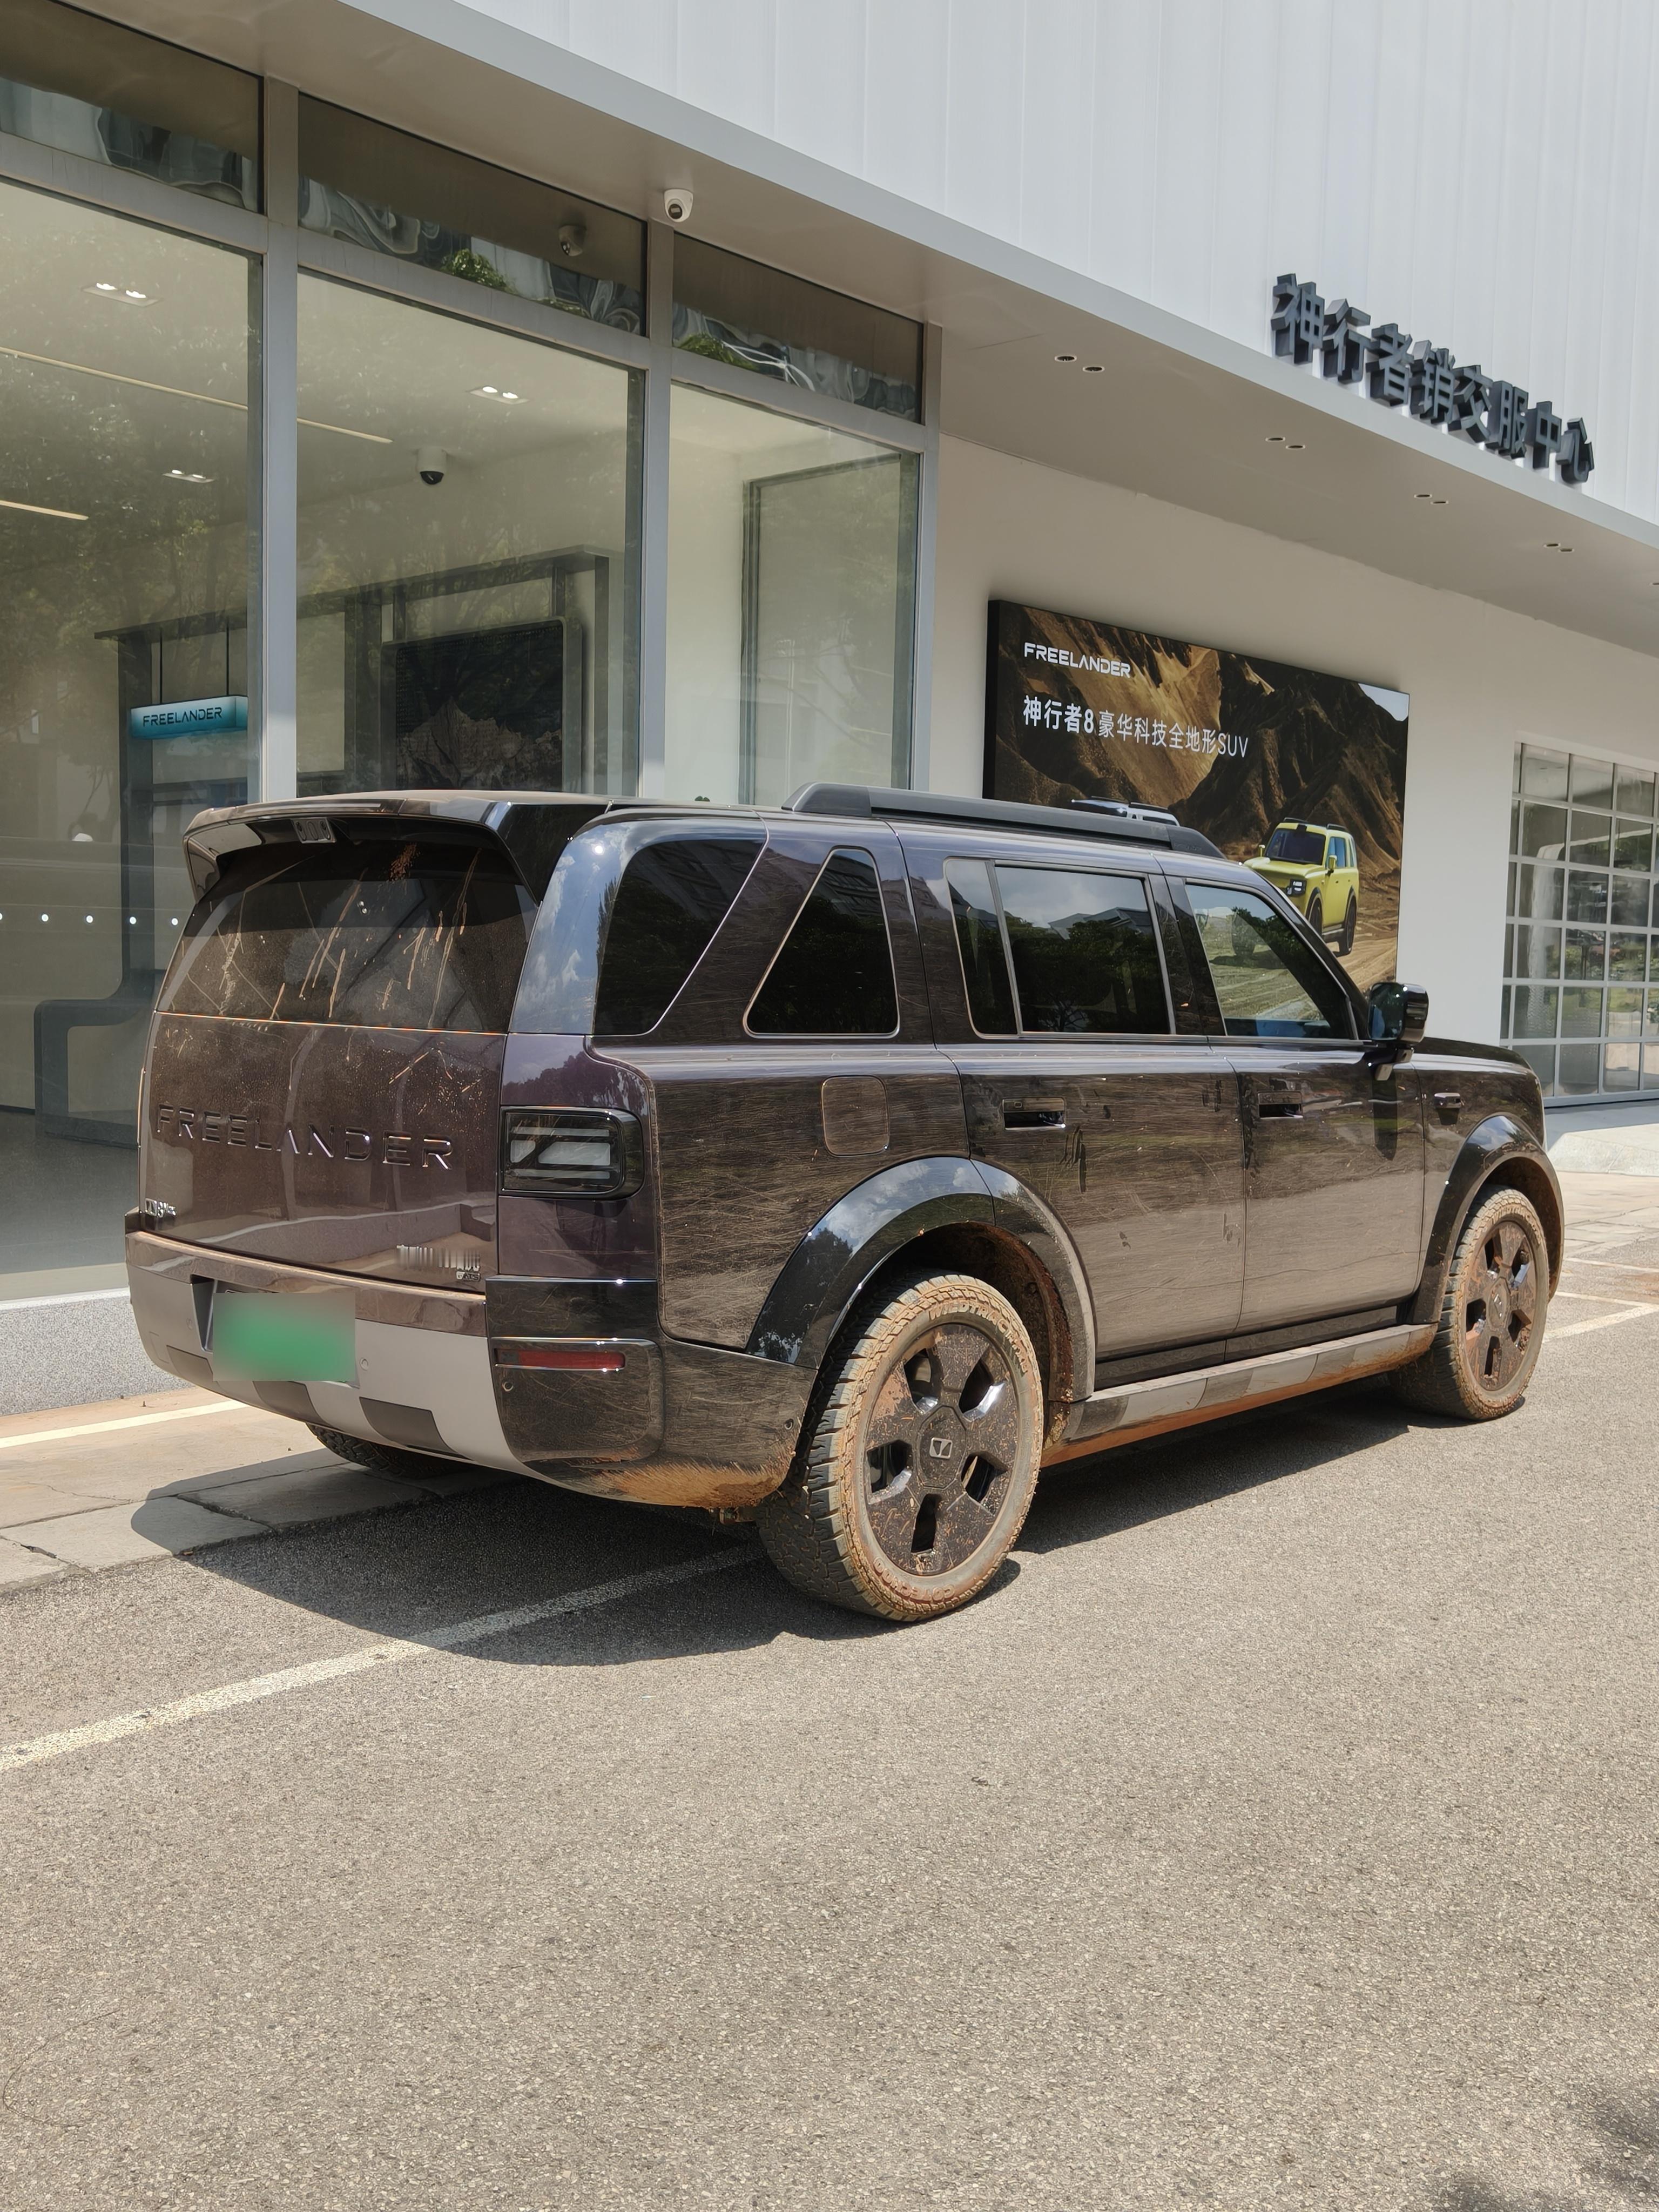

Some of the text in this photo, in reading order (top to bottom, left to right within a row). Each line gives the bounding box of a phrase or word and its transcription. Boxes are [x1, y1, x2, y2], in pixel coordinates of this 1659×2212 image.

[1271, 273, 1594, 482] 神行者销交服中心
[1024, 643, 1130, 678] FREELANDER
[143, 707, 222, 726] FREELANDER
[157, 1104, 453, 1169] FREELANDER
